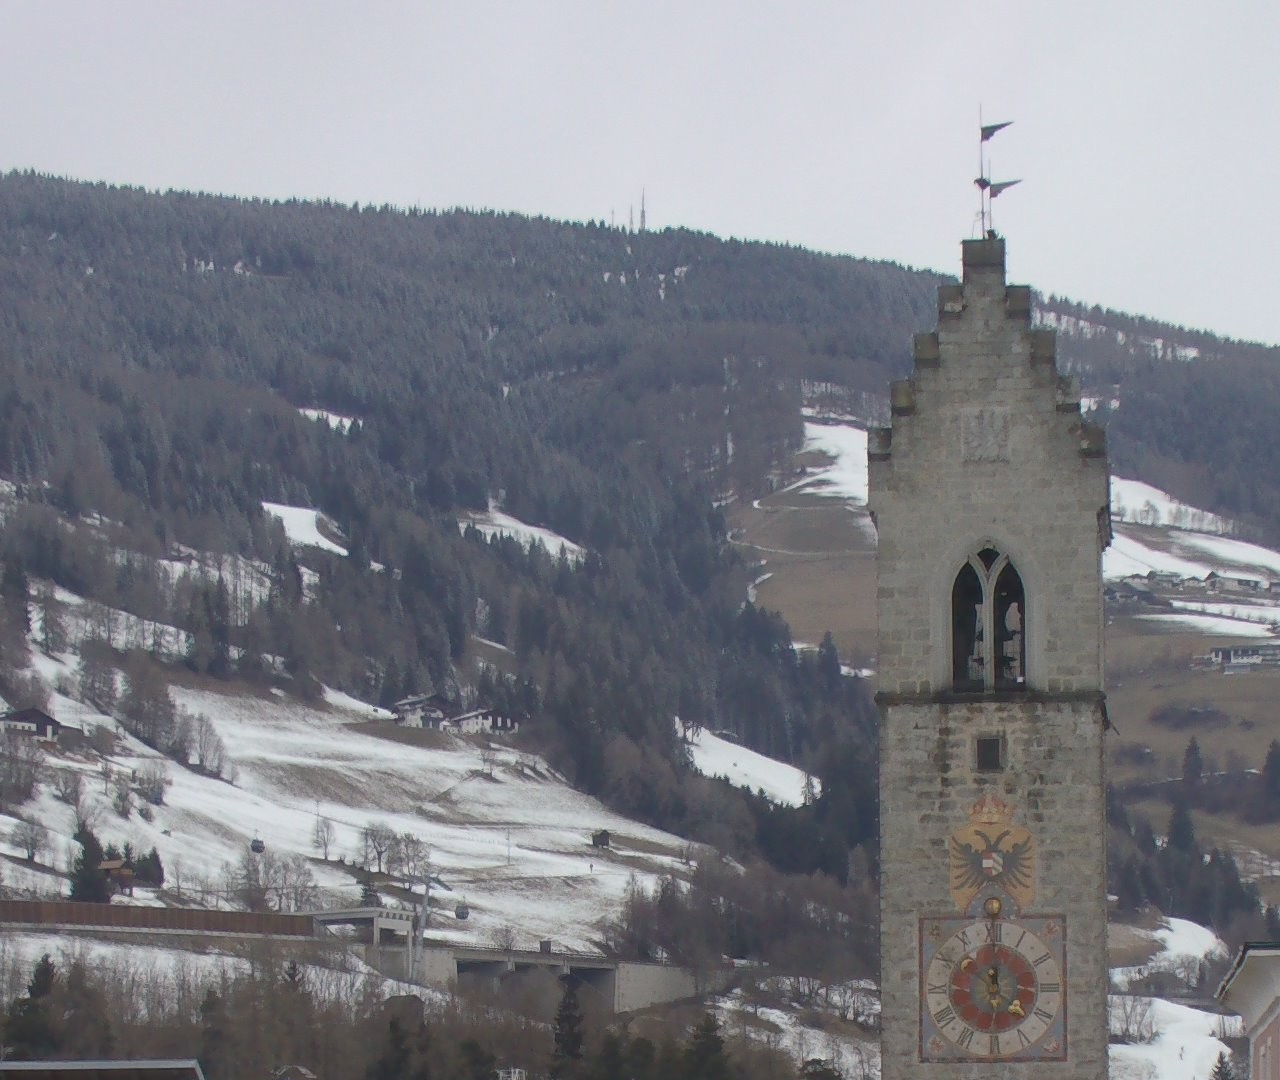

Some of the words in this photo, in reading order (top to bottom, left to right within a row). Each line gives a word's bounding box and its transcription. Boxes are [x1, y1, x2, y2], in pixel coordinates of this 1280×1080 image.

[1015, 930, 1026, 948] I
[1033, 952, 1051, 966] II
[1040, 983, 1059, 992] III
[989, 1035, 1001, 1054] VI
[1017, 1029, 1031, 1045] V
